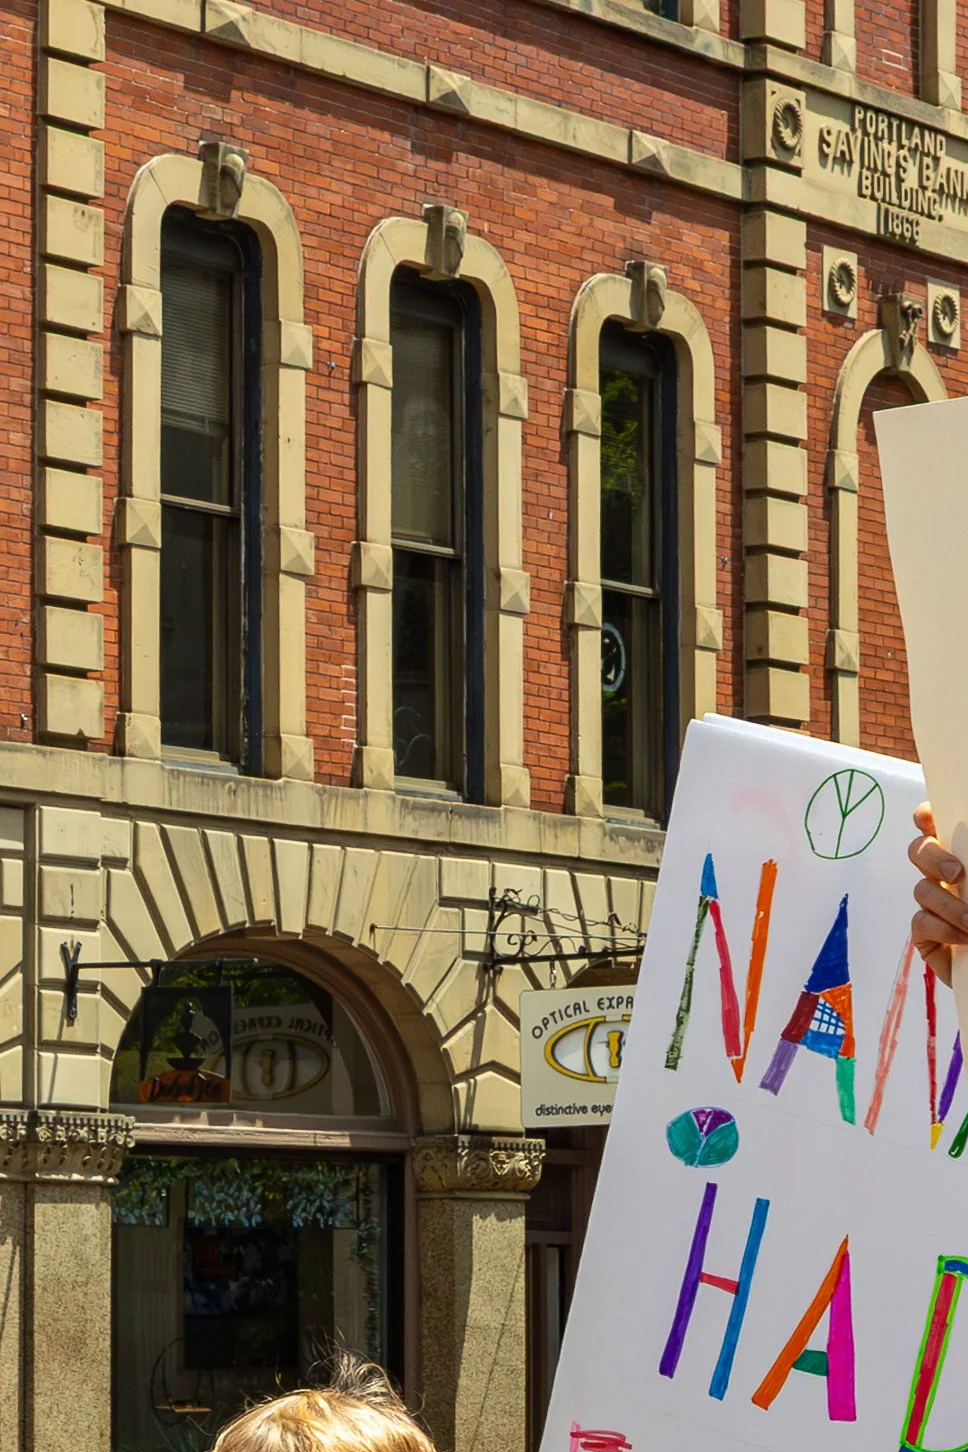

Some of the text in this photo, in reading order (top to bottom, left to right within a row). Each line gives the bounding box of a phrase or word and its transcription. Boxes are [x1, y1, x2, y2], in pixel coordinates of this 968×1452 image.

[818, 124, 911, 184] SAVINGS
[854, 104, 946, 158] PORTLAND
[531, 996, 634, 1039] OPTICAL EXPR
[535, 1103, 614, 1116] distinctive eye
